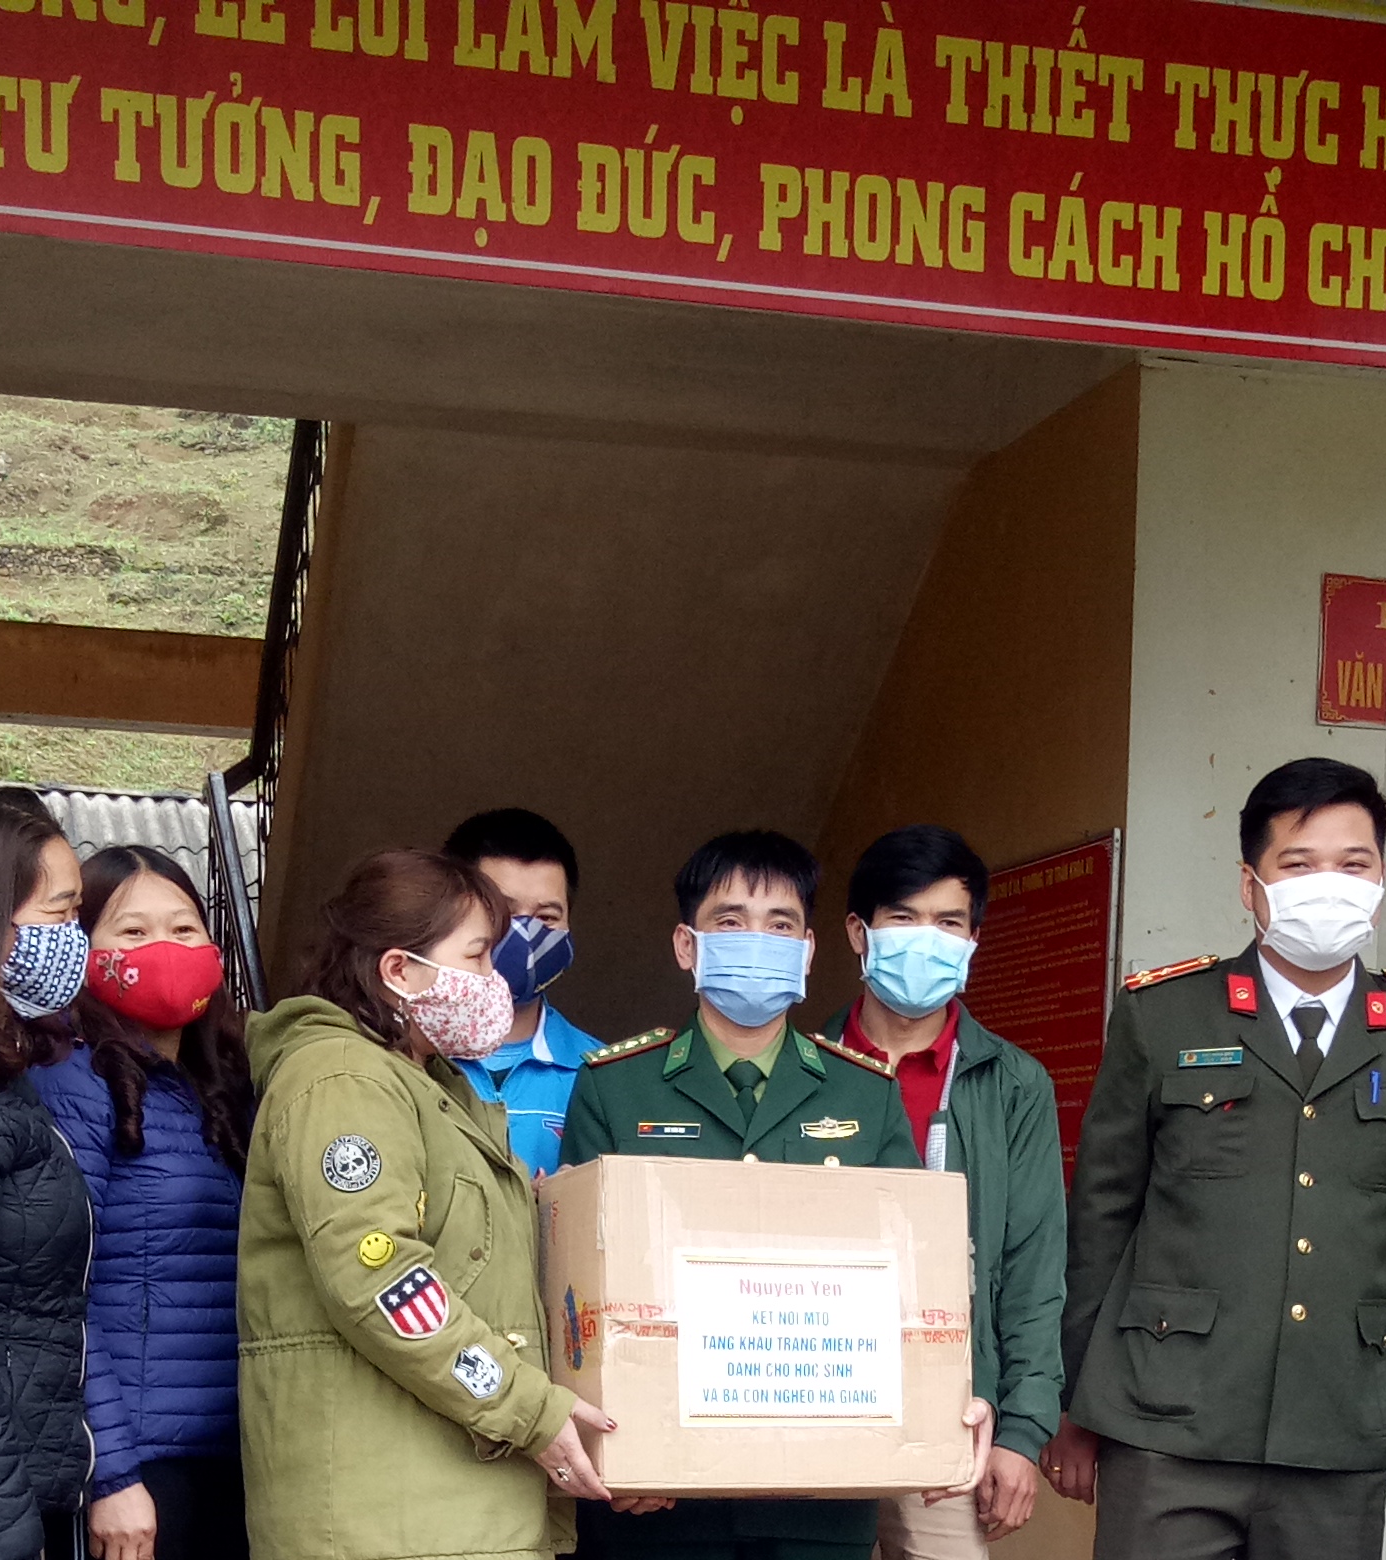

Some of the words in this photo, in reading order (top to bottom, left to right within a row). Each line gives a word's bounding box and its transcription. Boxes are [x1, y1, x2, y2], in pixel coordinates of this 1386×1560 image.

[640, 0, 799, 125] VIỆC
[822, 2, 912, 118] LÀ
[936, 6, 1143, 143] THIẾT
[1164, 62, 1338, 185] THỰC
[100, 72, 381, 225] TƯỞNG,
[408, 124, 551, 248] ĐẠO
[577, 124, 733, 262] ĐỨC,
[759, 162, 986, 273] PHONG
[1009, 172, 1183, 293] CÁCH
[1202, 170, 1286, 302] HỒ
[1337, 650, 1383, 709] VĂN
[777, 1337, 816, 1351] TRANG
[766, 1363, 789, 1377] CHO
[824, 1363, 853, 1378] SINH
[744, 1389, 768, 1403] CON
[840, 1390, 877, 1404] GIANG
